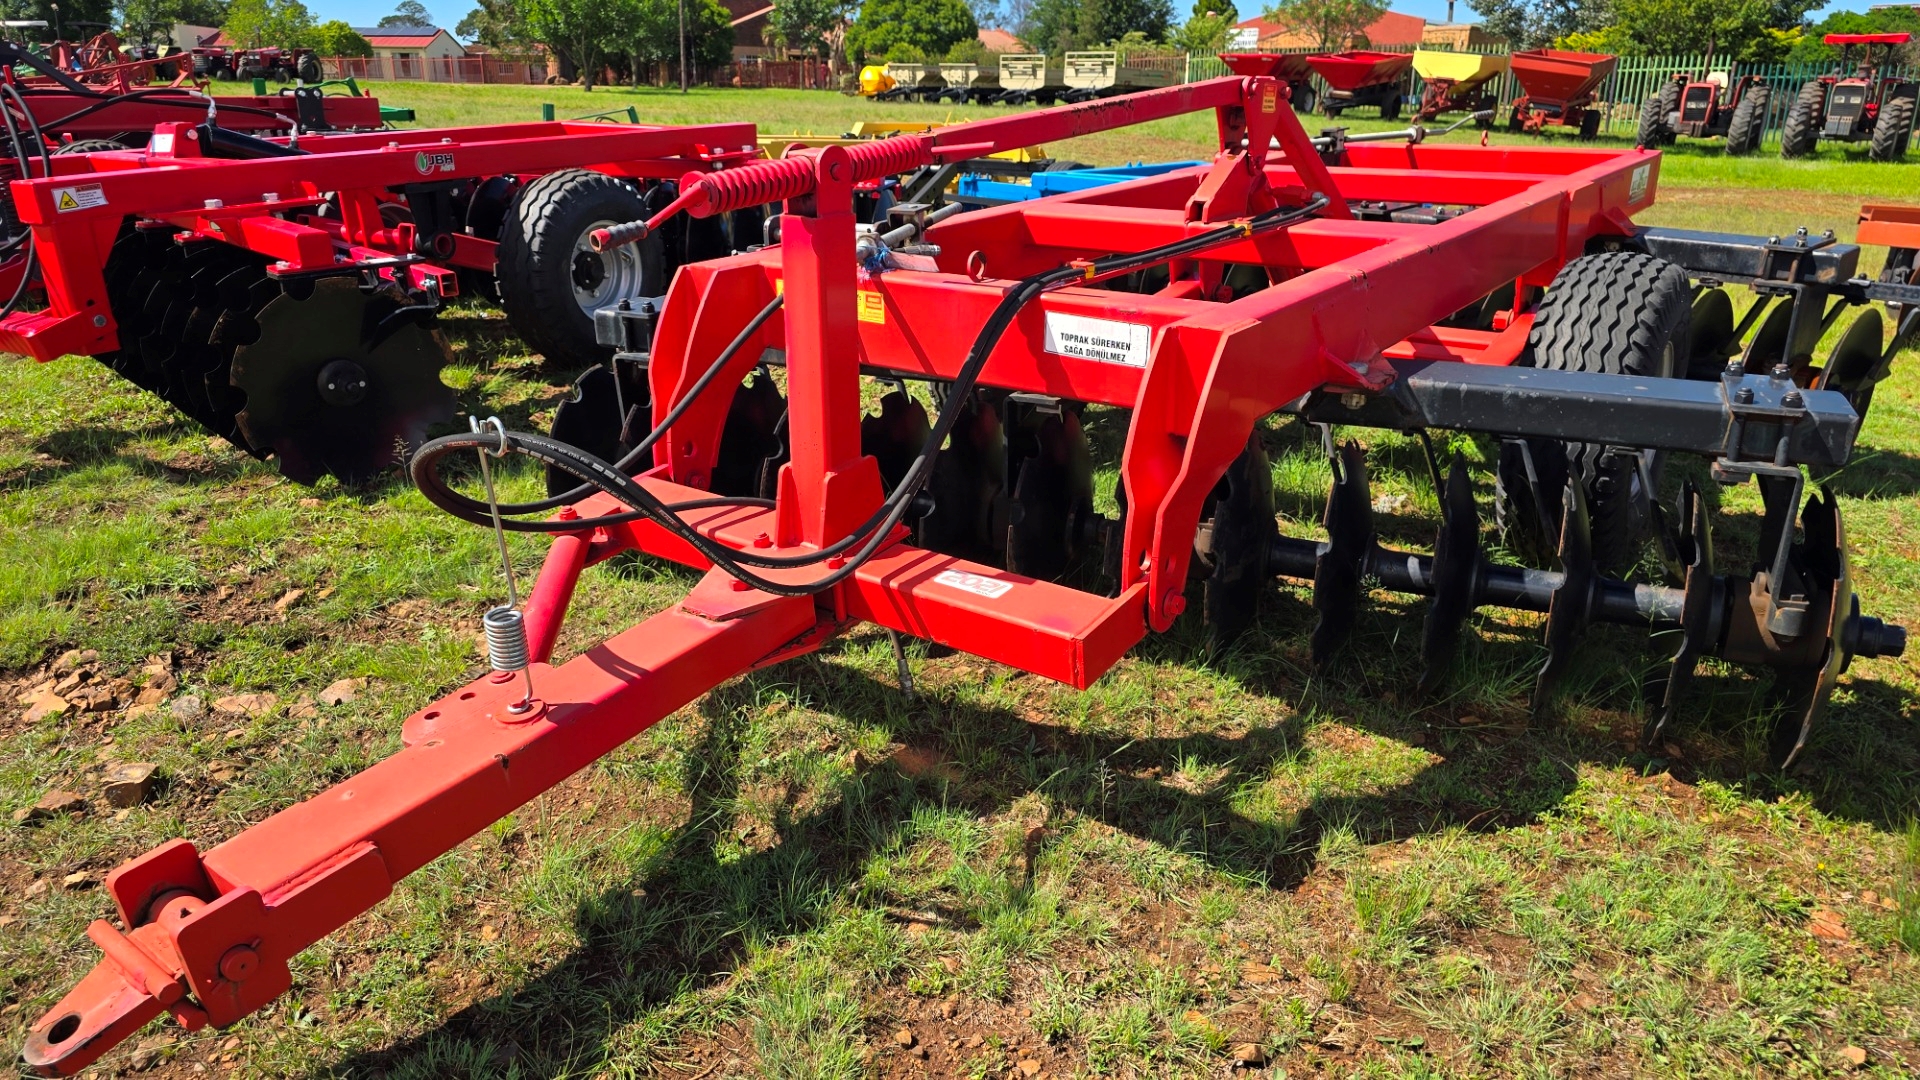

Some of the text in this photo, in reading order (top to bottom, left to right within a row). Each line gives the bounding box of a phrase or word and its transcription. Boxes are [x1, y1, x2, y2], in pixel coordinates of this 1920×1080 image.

[428, 154, 454, 166] JBH
[1060, 332, 1131, 351] TOPRAK SÜRERKEN
[1064, 345, 1126, 362] SAĞA DÖNÜLMEZ
